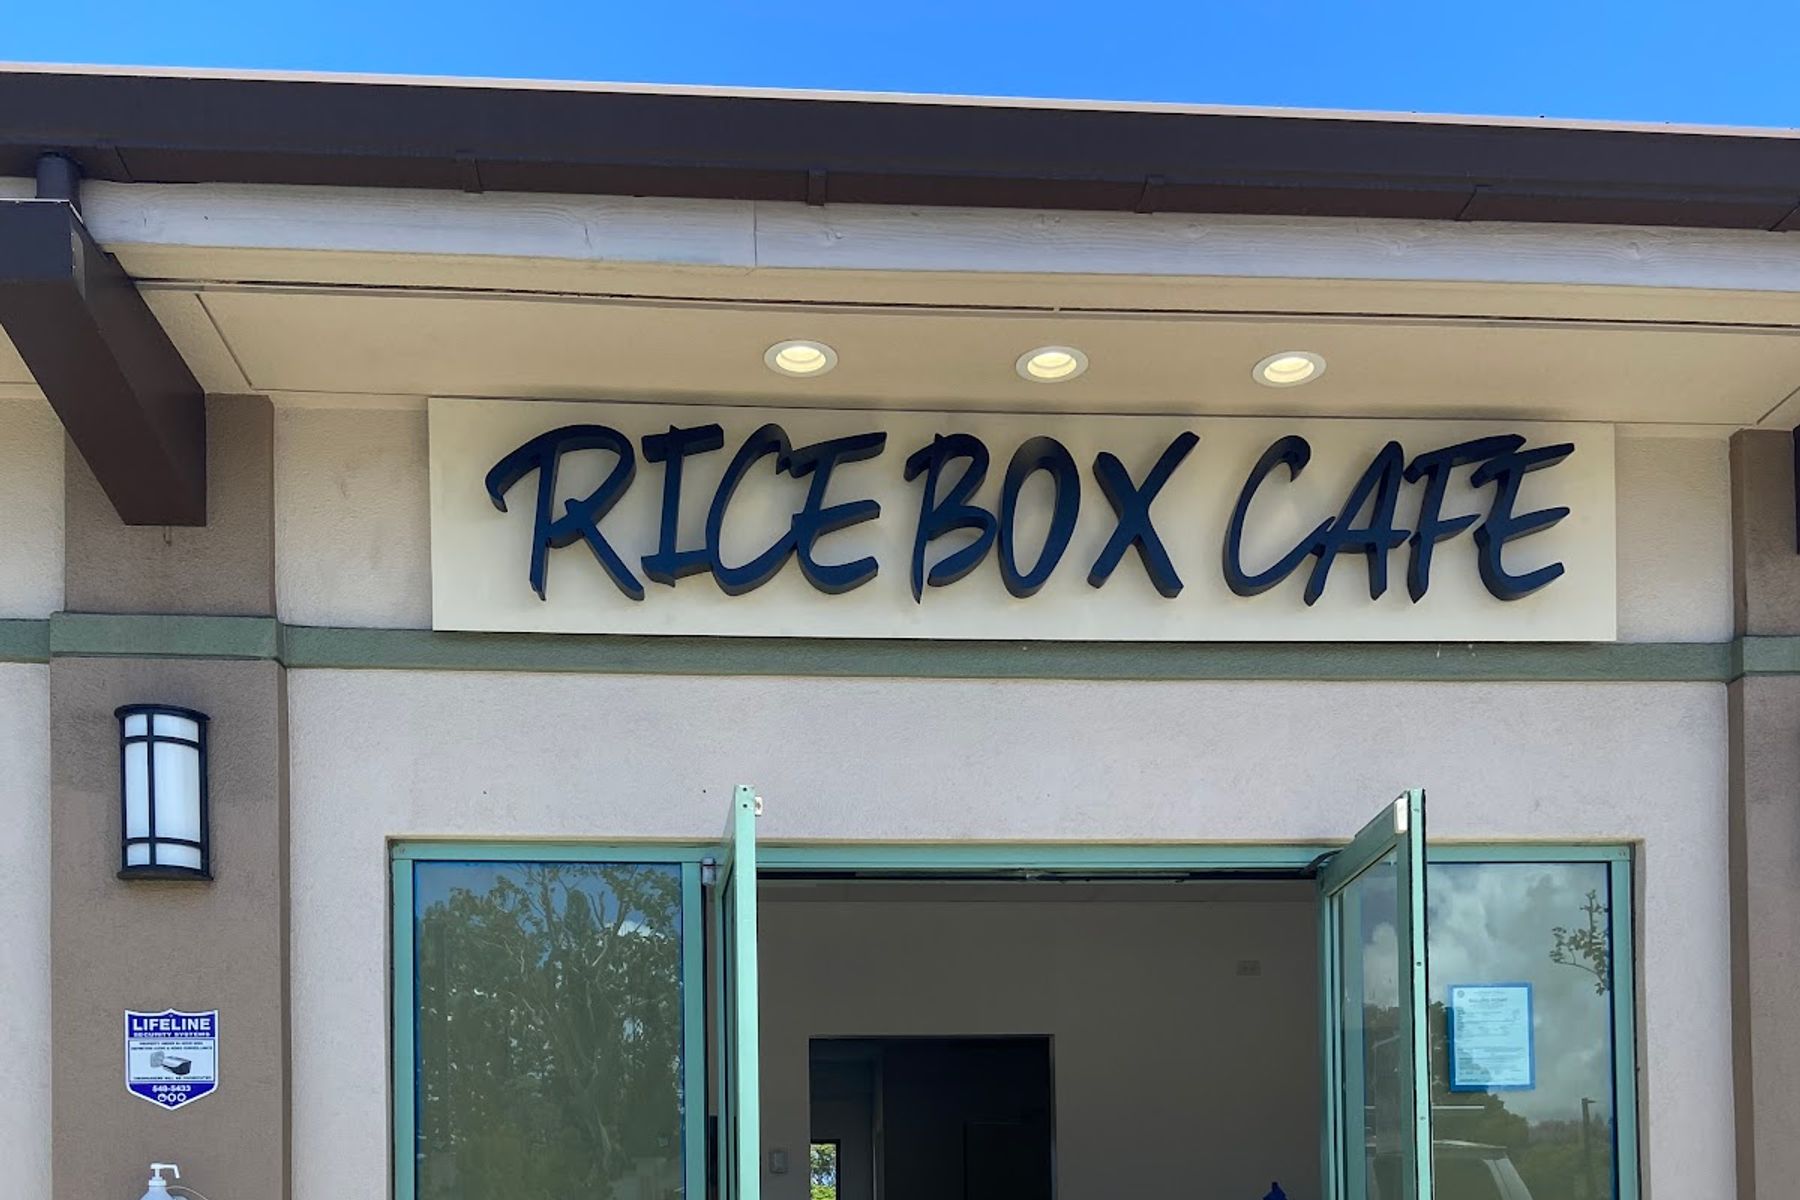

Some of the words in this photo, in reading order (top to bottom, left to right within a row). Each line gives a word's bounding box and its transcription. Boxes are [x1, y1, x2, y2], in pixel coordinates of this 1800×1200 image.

[485, 423, 887, 600] RICE
[905, 430, 1199, 604] BOX
[1222, 433, 1575, 605] CAFE
[133, 1018, 211, 1031] LIFELINE
